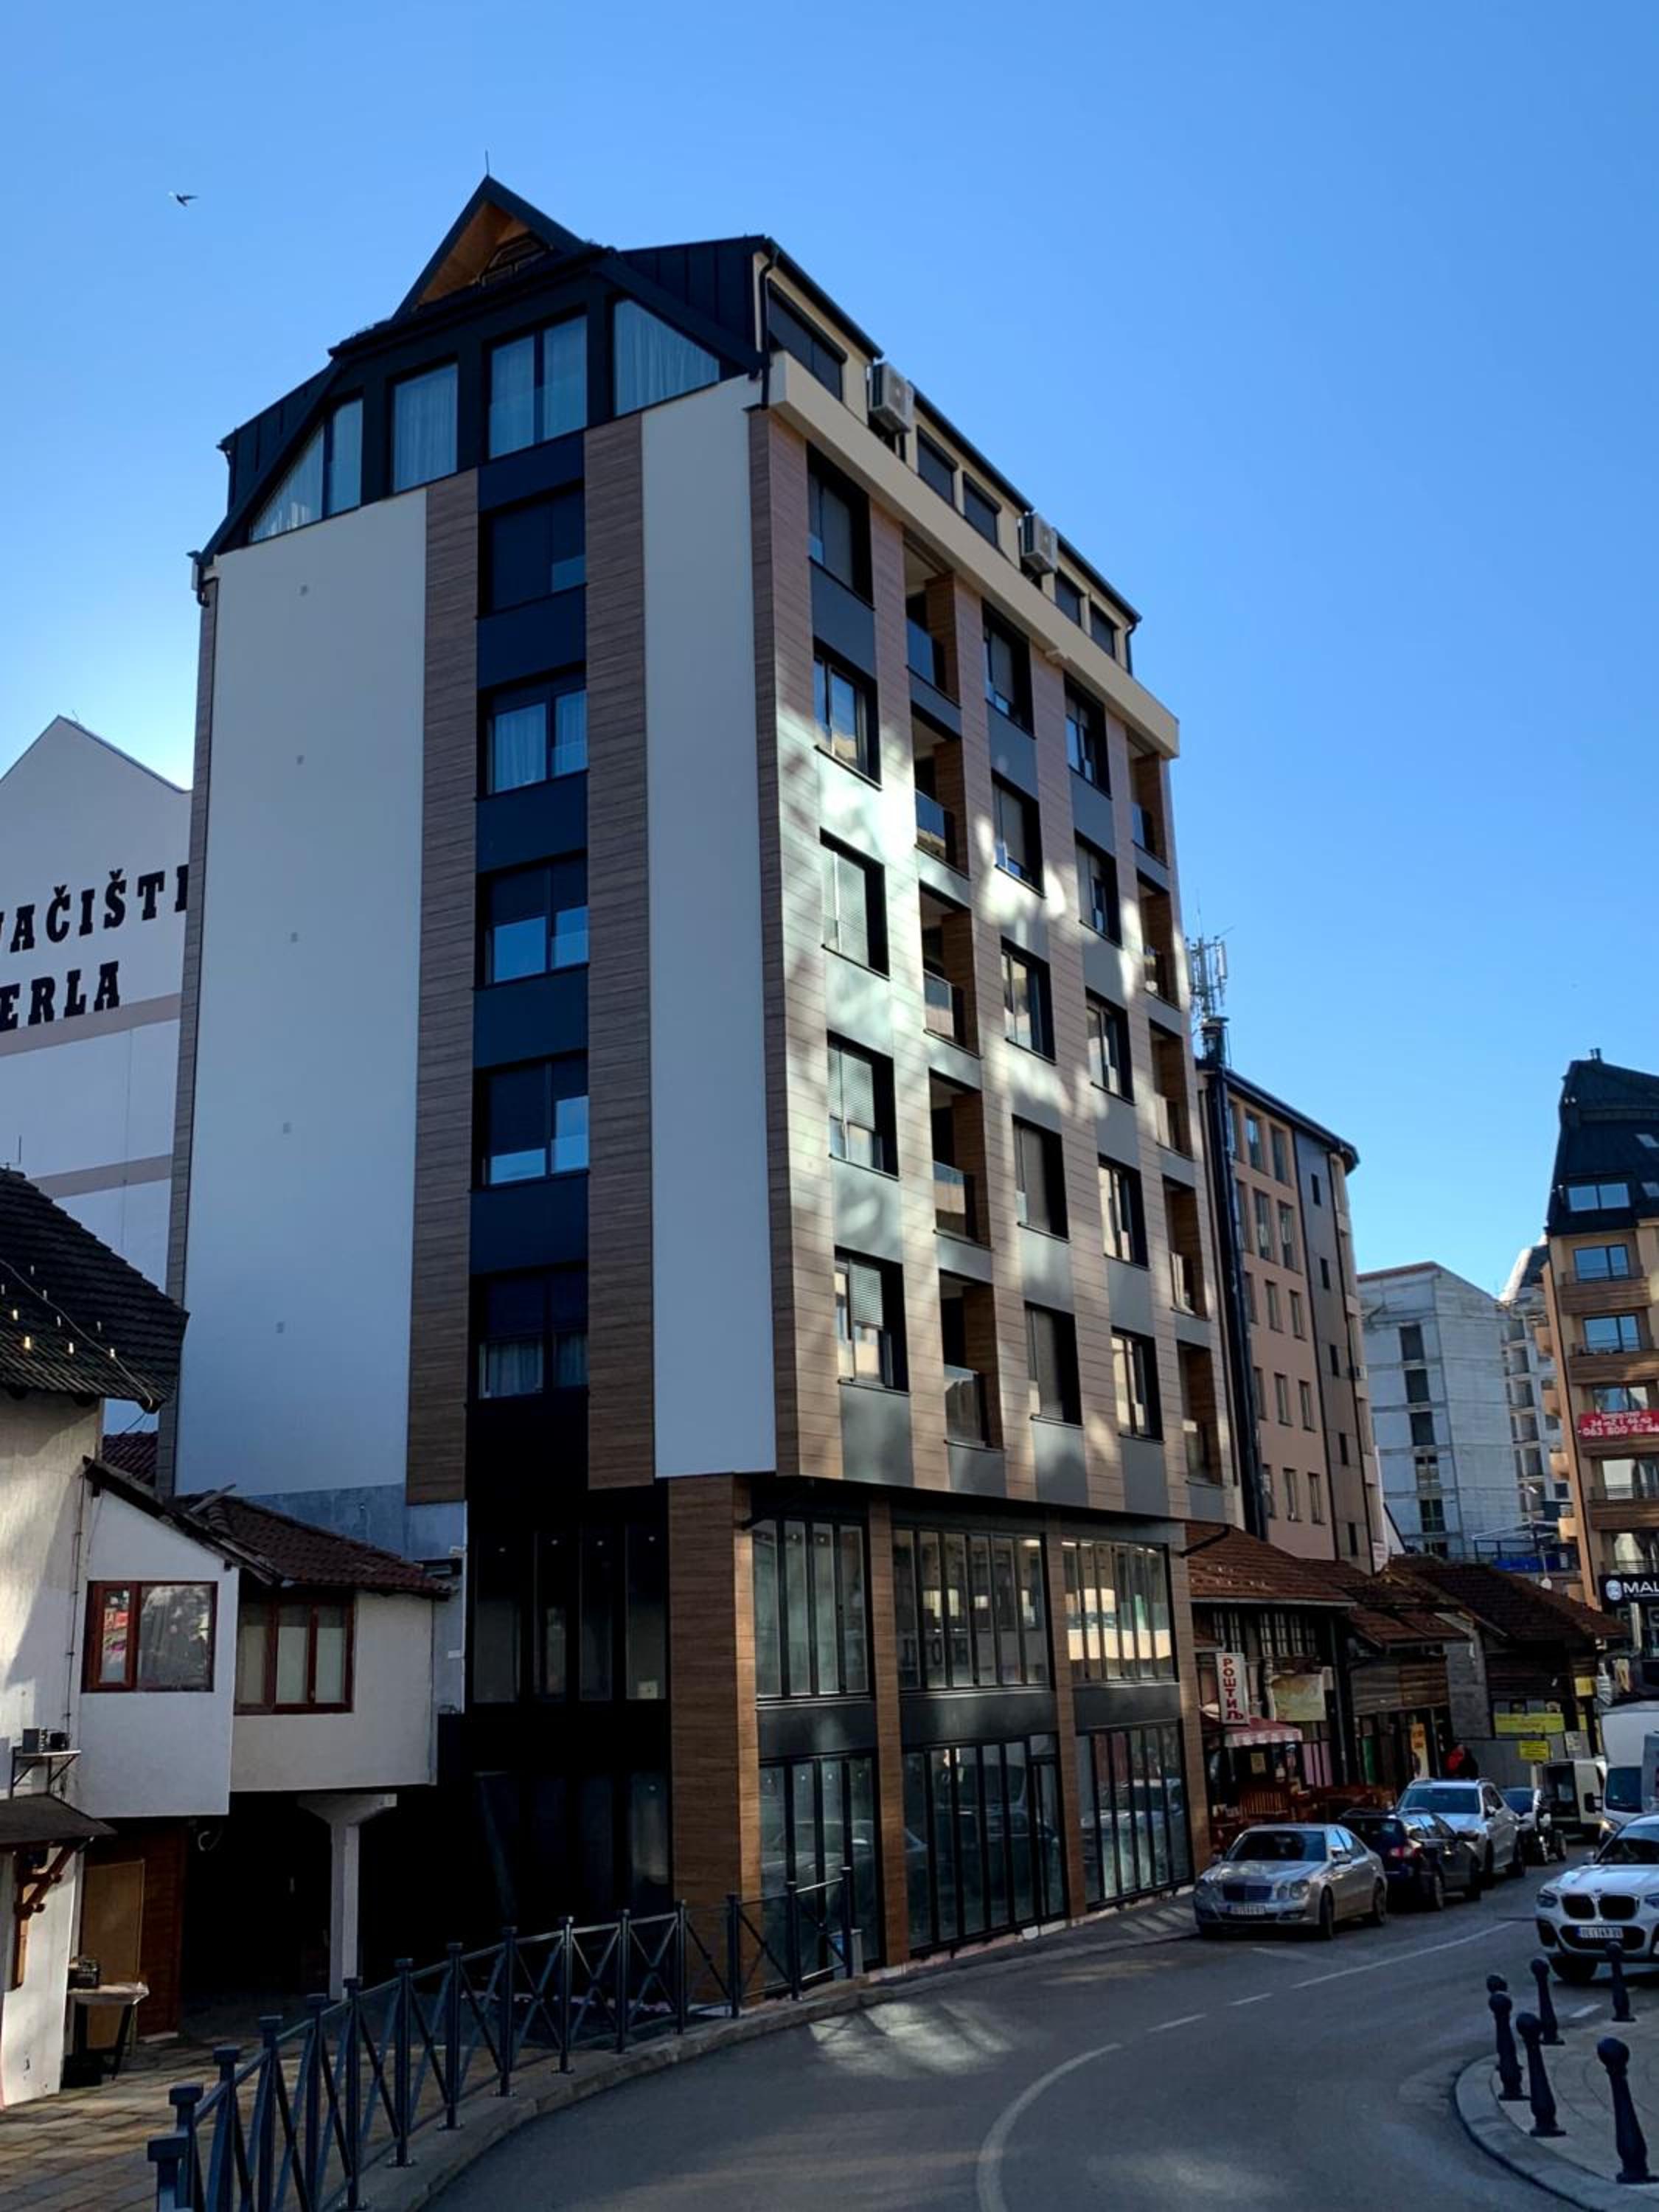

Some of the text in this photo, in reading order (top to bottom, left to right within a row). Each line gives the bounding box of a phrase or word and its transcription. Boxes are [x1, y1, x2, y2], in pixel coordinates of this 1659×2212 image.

[0, 863, 189, 953] AČIŠT
[0, 961, 120, 1032] ERLA
[1222, 1658, 1244, 1720] РОШТИЉ
